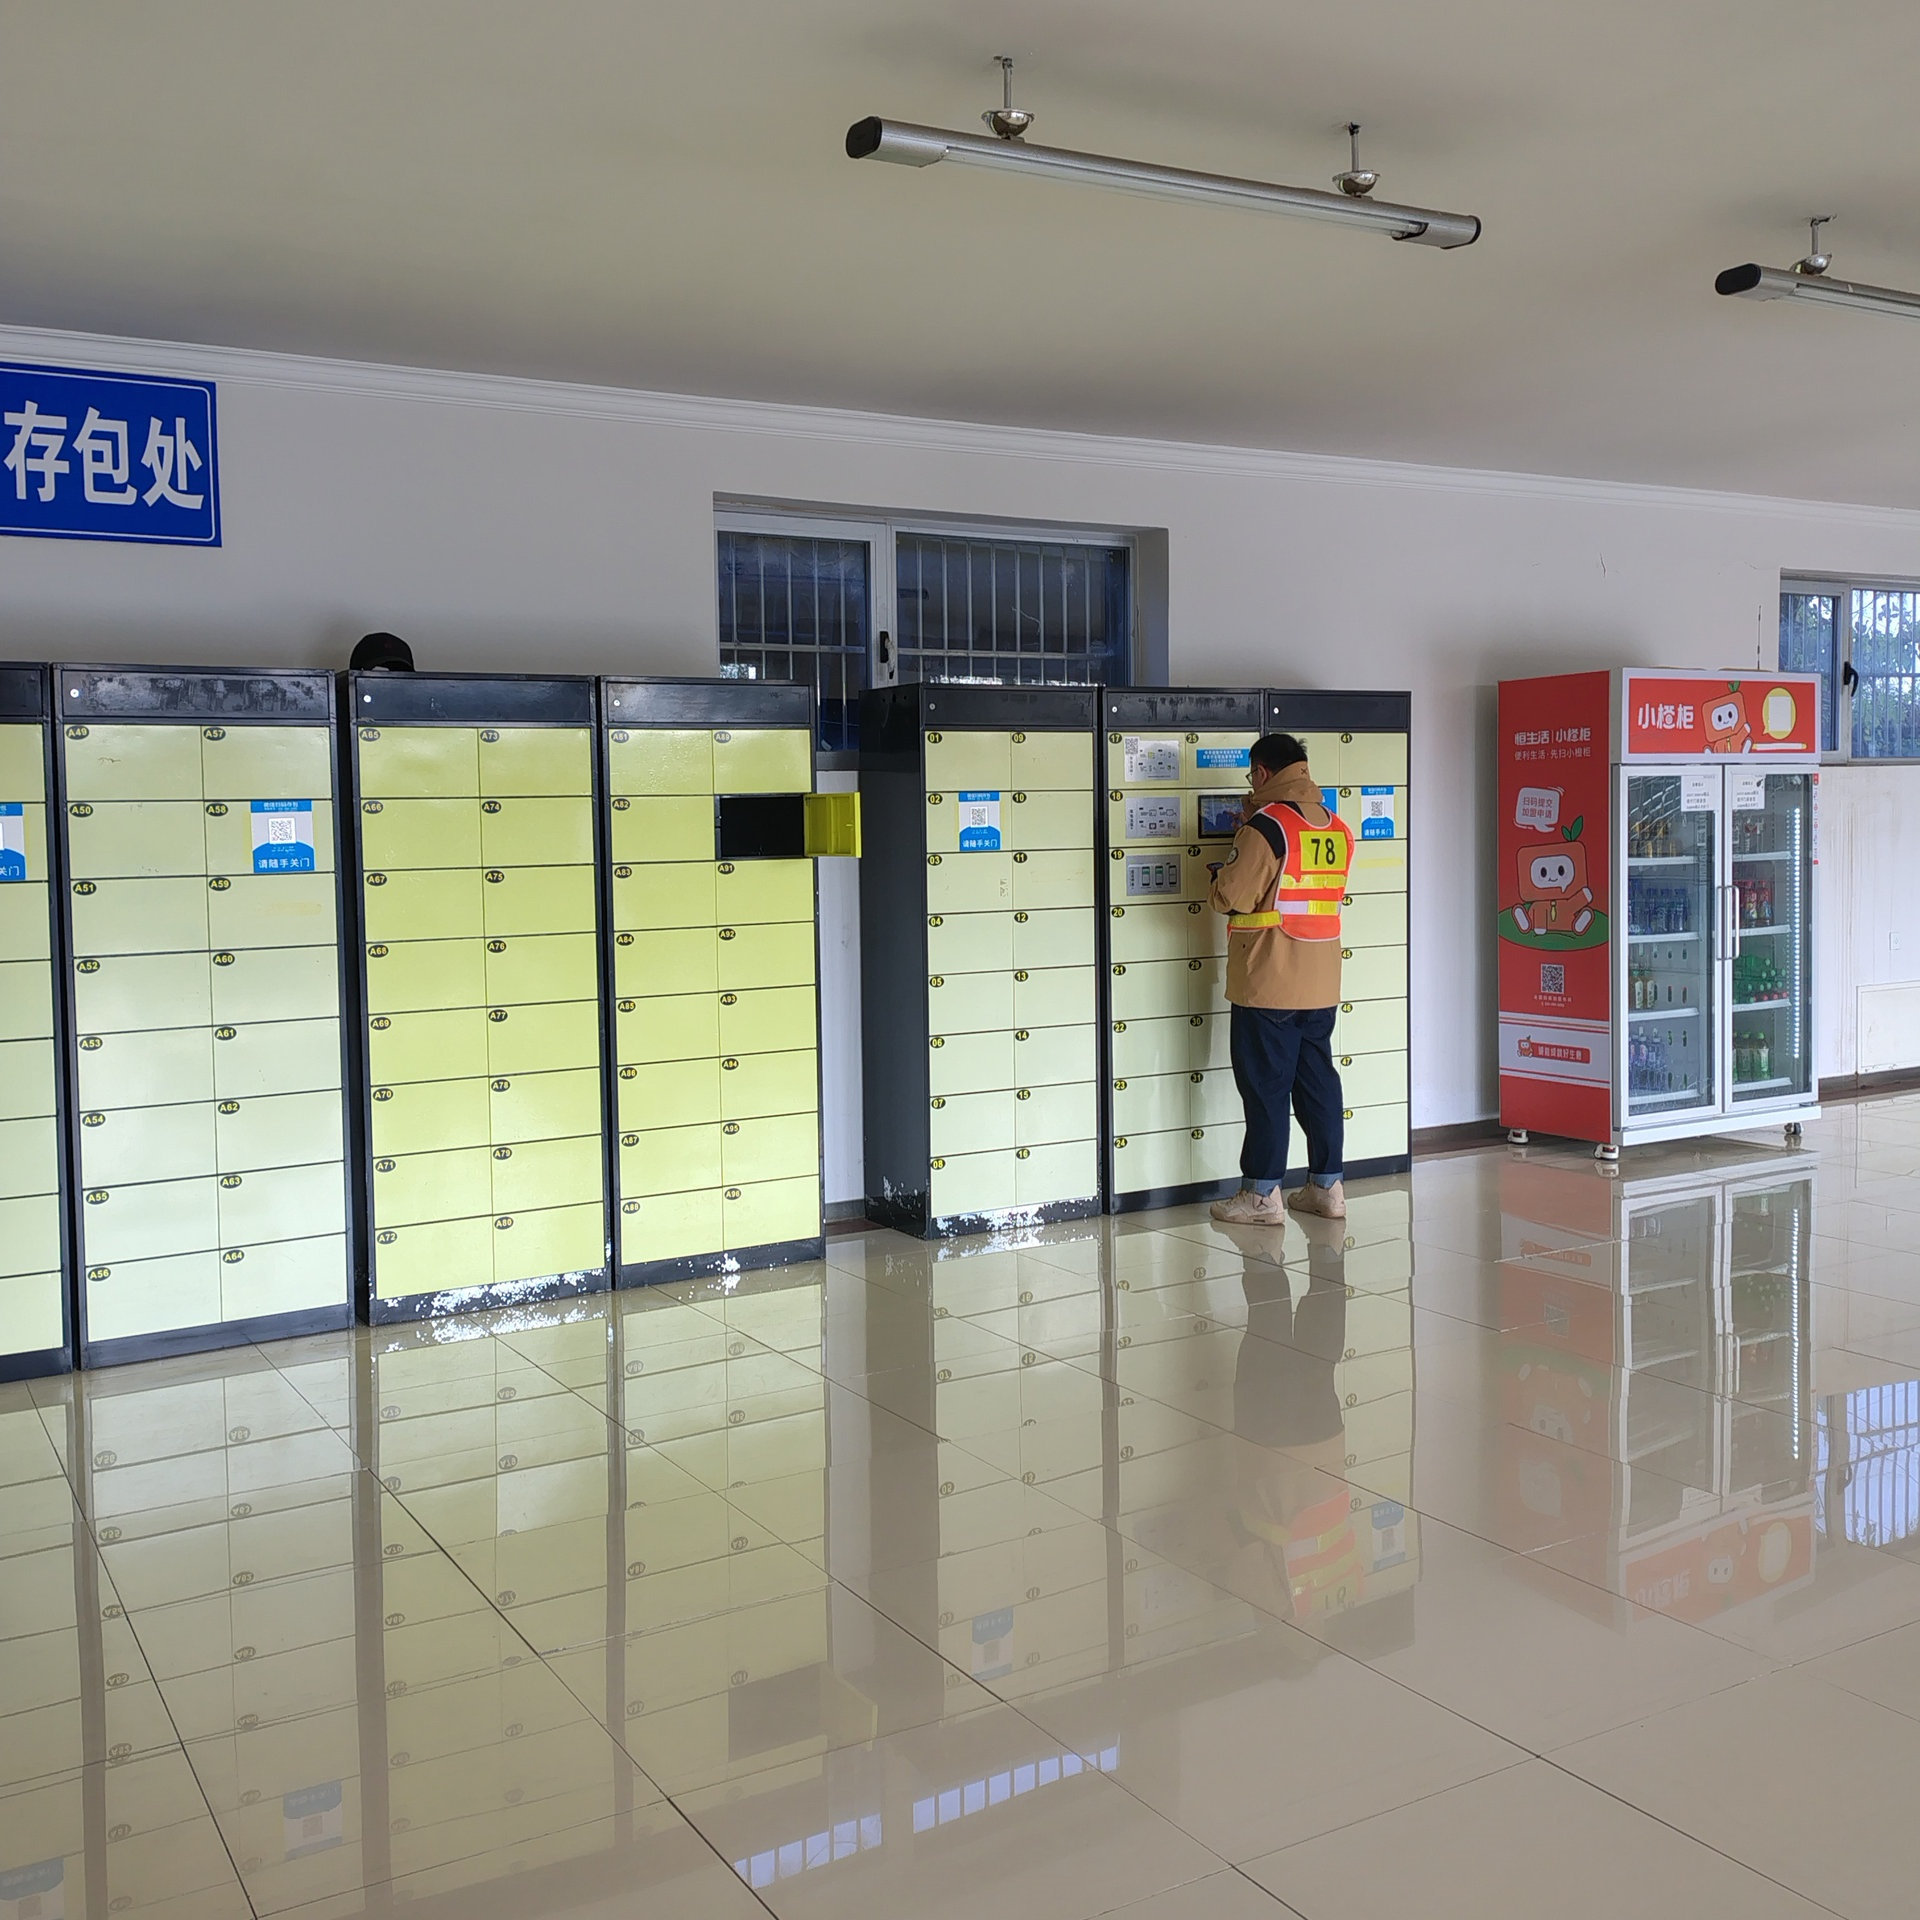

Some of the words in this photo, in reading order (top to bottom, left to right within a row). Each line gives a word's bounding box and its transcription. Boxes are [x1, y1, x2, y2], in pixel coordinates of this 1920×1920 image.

[3, 400, 204, 510] 存包处
[1638, 703, 1694, 730] 小橙柜
[67, 727, 87, 737] A49
[205, 729, 223, 737] A57
[361, 730, 379, 738] A65
[481, 731, 498, 740] A73
[1556, 728, 1591, 743] 小橙柜
[929, 733, 939, 742] 01
[1013, 733, 1024, 742] 09
[1110, 734, 1120, 742] 17
[1187, 734, 1197, 742] 25
[929, 794, 940, 803] 02
[1014, 793, 1024, 801] 10
[1111, 791, 1121, 800] 18
[71, 805, 91, 814] A50
[207, 805, 226, 813] A58
[364, 803, 382, 811] A66
[962, 839, 998, 848] 请随手关门
[1113, 850, 1122, 858] 19
[1189, 847, 1198, 855] 27
[1311, 838, 1336, 865] 78
[929, 855, 940, 864] 03
[1015, 853, 1024, 861] 11
[258, 858, 310, 869] 请随手关门
[367, 875, 385, 883] A67
[486, 872, 503, 880] A75
[74, 883, 93, 892] A51
[210, 879, 229, 888] A59
[1113, 908, 1122, 916] 20
[1190, 904, 1199, 912] 28
[930, 917, 941, 926] 04
[1016, 913, 1026, 921] 12
[369, 946, 386, 955] A68
[214, 954, 233, 963] A60
[78, 961, 98, 971] A52
[1190, 961, 1199, 969] 29
[1114, 966, 1123, 974] 21
[1016, 972, 1026, 980] 13
[931, 977, 942, 986] 05
[721, 995, 737, 1003] A93
[372, 1019, 389, 1027] A69
[1191, 1017, 1201, 1025] 30
[1115, 1023, 1124, 1031] 22
[216, 1029, 234, 1038] A61
[1017, 1031, 1027, 1040] 14
[81, 1038, 100, 1047] A53
[931, 1038, 942, 1047] 06
[1192, 1073, 1200, 1082] 31
[492, 1081, 508, 1089] A78
[1115, 1081, 1125, 1089] 23
[374, 1090, 392, 1098] A70
[1018, 1090, 1028, 1099] 15
[219, 1102, 238, 1112] A62
[932, 1098, 943, 1108] 07
[84, 1115, 106, 1124] A54
[1193, 1130, 1204, 1138] 32
[622, 1136, 637, 1144] A87
[1115, 1139, 1125, 1147] 24
[494, 1149, 510, 1157] A79
[1018, 1149, 1028, 1158] 16
[376, 1161, 393, 1170] A71
[932, 1159, 943, 1168] 08
[221, 1177, 240, 1186] A63
[87, 1192, 107, 1202] A55
[495, 1218, 512, 1227] A80
[378, 1232, 395, 1241] A72
[224, 1251, 242, 1261] A64
[89, 1269, 109, 1279] A56
